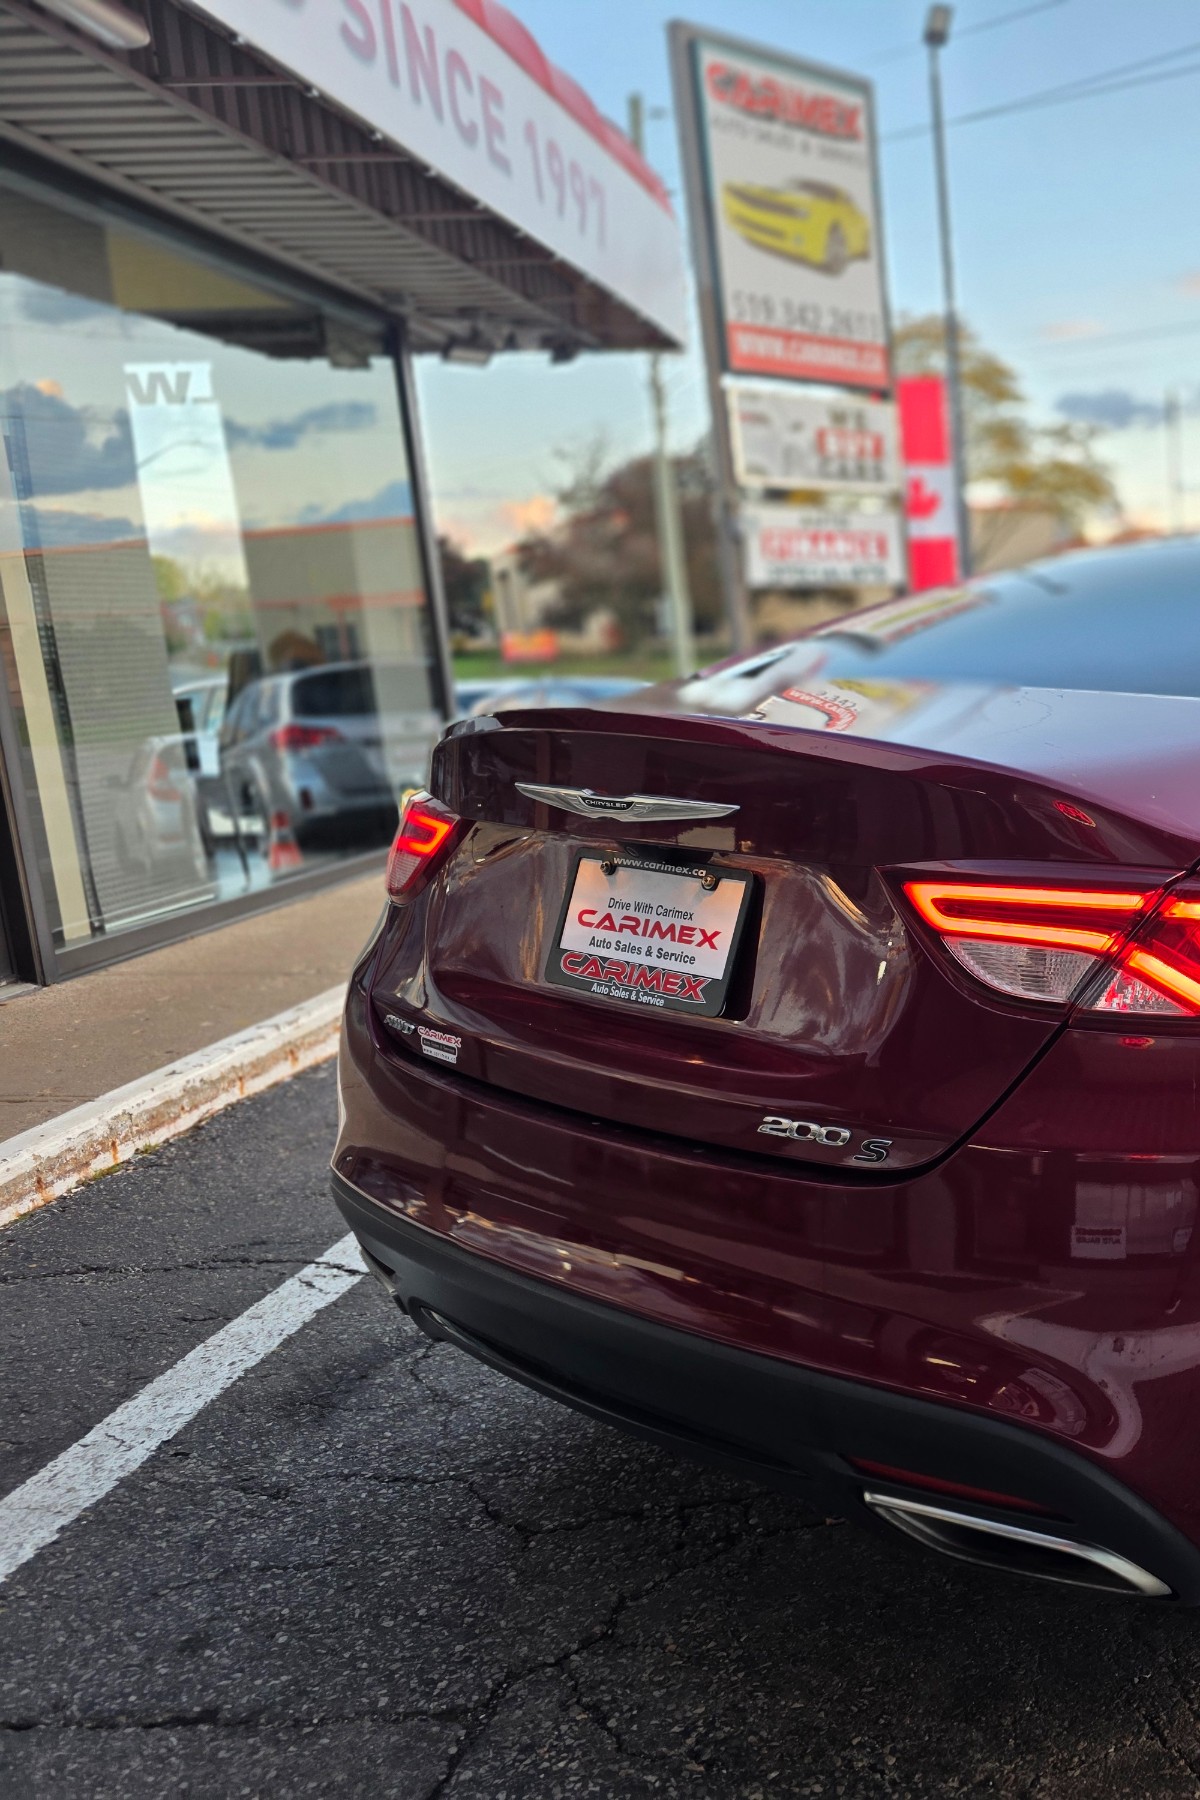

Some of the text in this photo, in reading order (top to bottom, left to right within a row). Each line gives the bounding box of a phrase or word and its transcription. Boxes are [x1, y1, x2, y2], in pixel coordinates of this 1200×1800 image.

[341, 0, 609, 250] SINCE 1997
[585, 798, 628, 809] CHRYSLER
[613, 856, 707, 877] www.carimex.ca
[607, 897, 695, 921] Drive With Carimex
[577, 908, 722, 950] CARIMEX
[588, 936, 696, 965] Auto Sales & Service
[561, 951, 711, 1003] CARIMEX
[591, 982, 665, 1007] Auto Sales & Service
[417, 1026, 462, 1048] CARIMEX
[757, 1115, 893, 1163] 200 S
